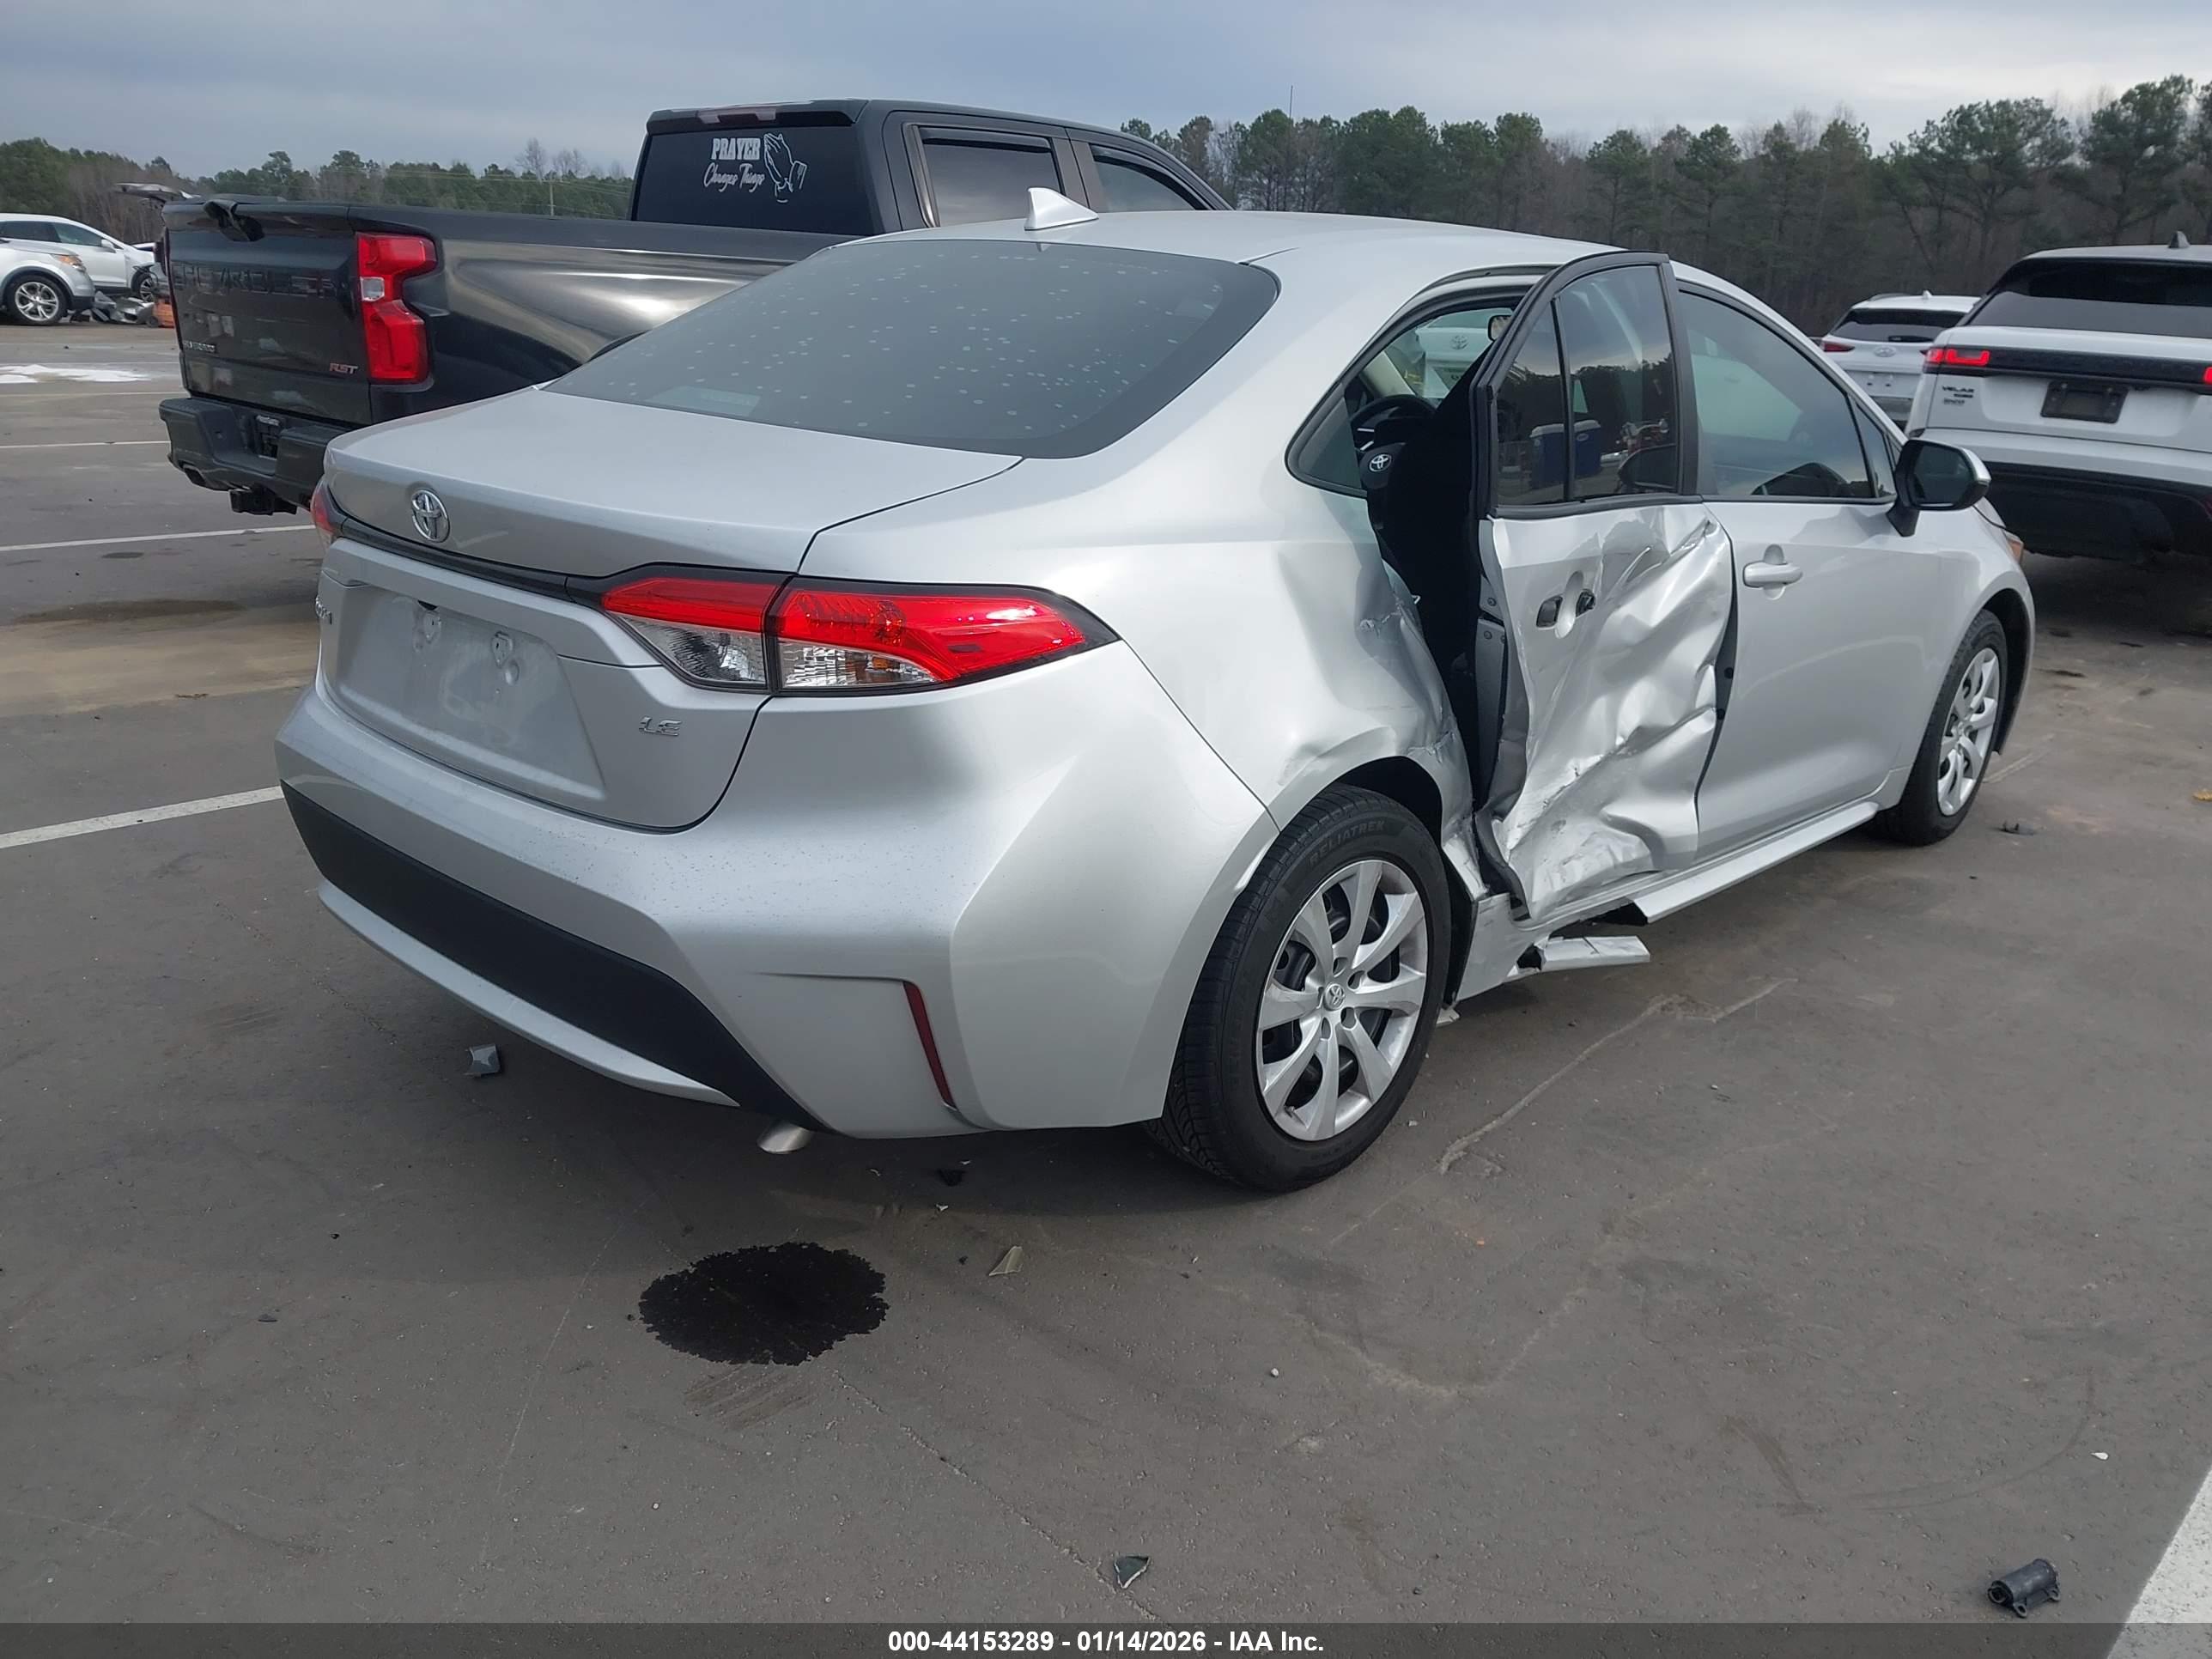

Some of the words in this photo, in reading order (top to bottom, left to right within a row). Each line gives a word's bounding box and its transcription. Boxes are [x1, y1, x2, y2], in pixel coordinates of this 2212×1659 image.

[711, 137, 761, 161] PRAYER
[703, 162, 738, 192] Changes
[739, 162, 765, 193] Things
[329, 362, 359, 374] RST
[639, 716, 682, 737] LE
[1307, 820, 1386, 868] RELIATREK
